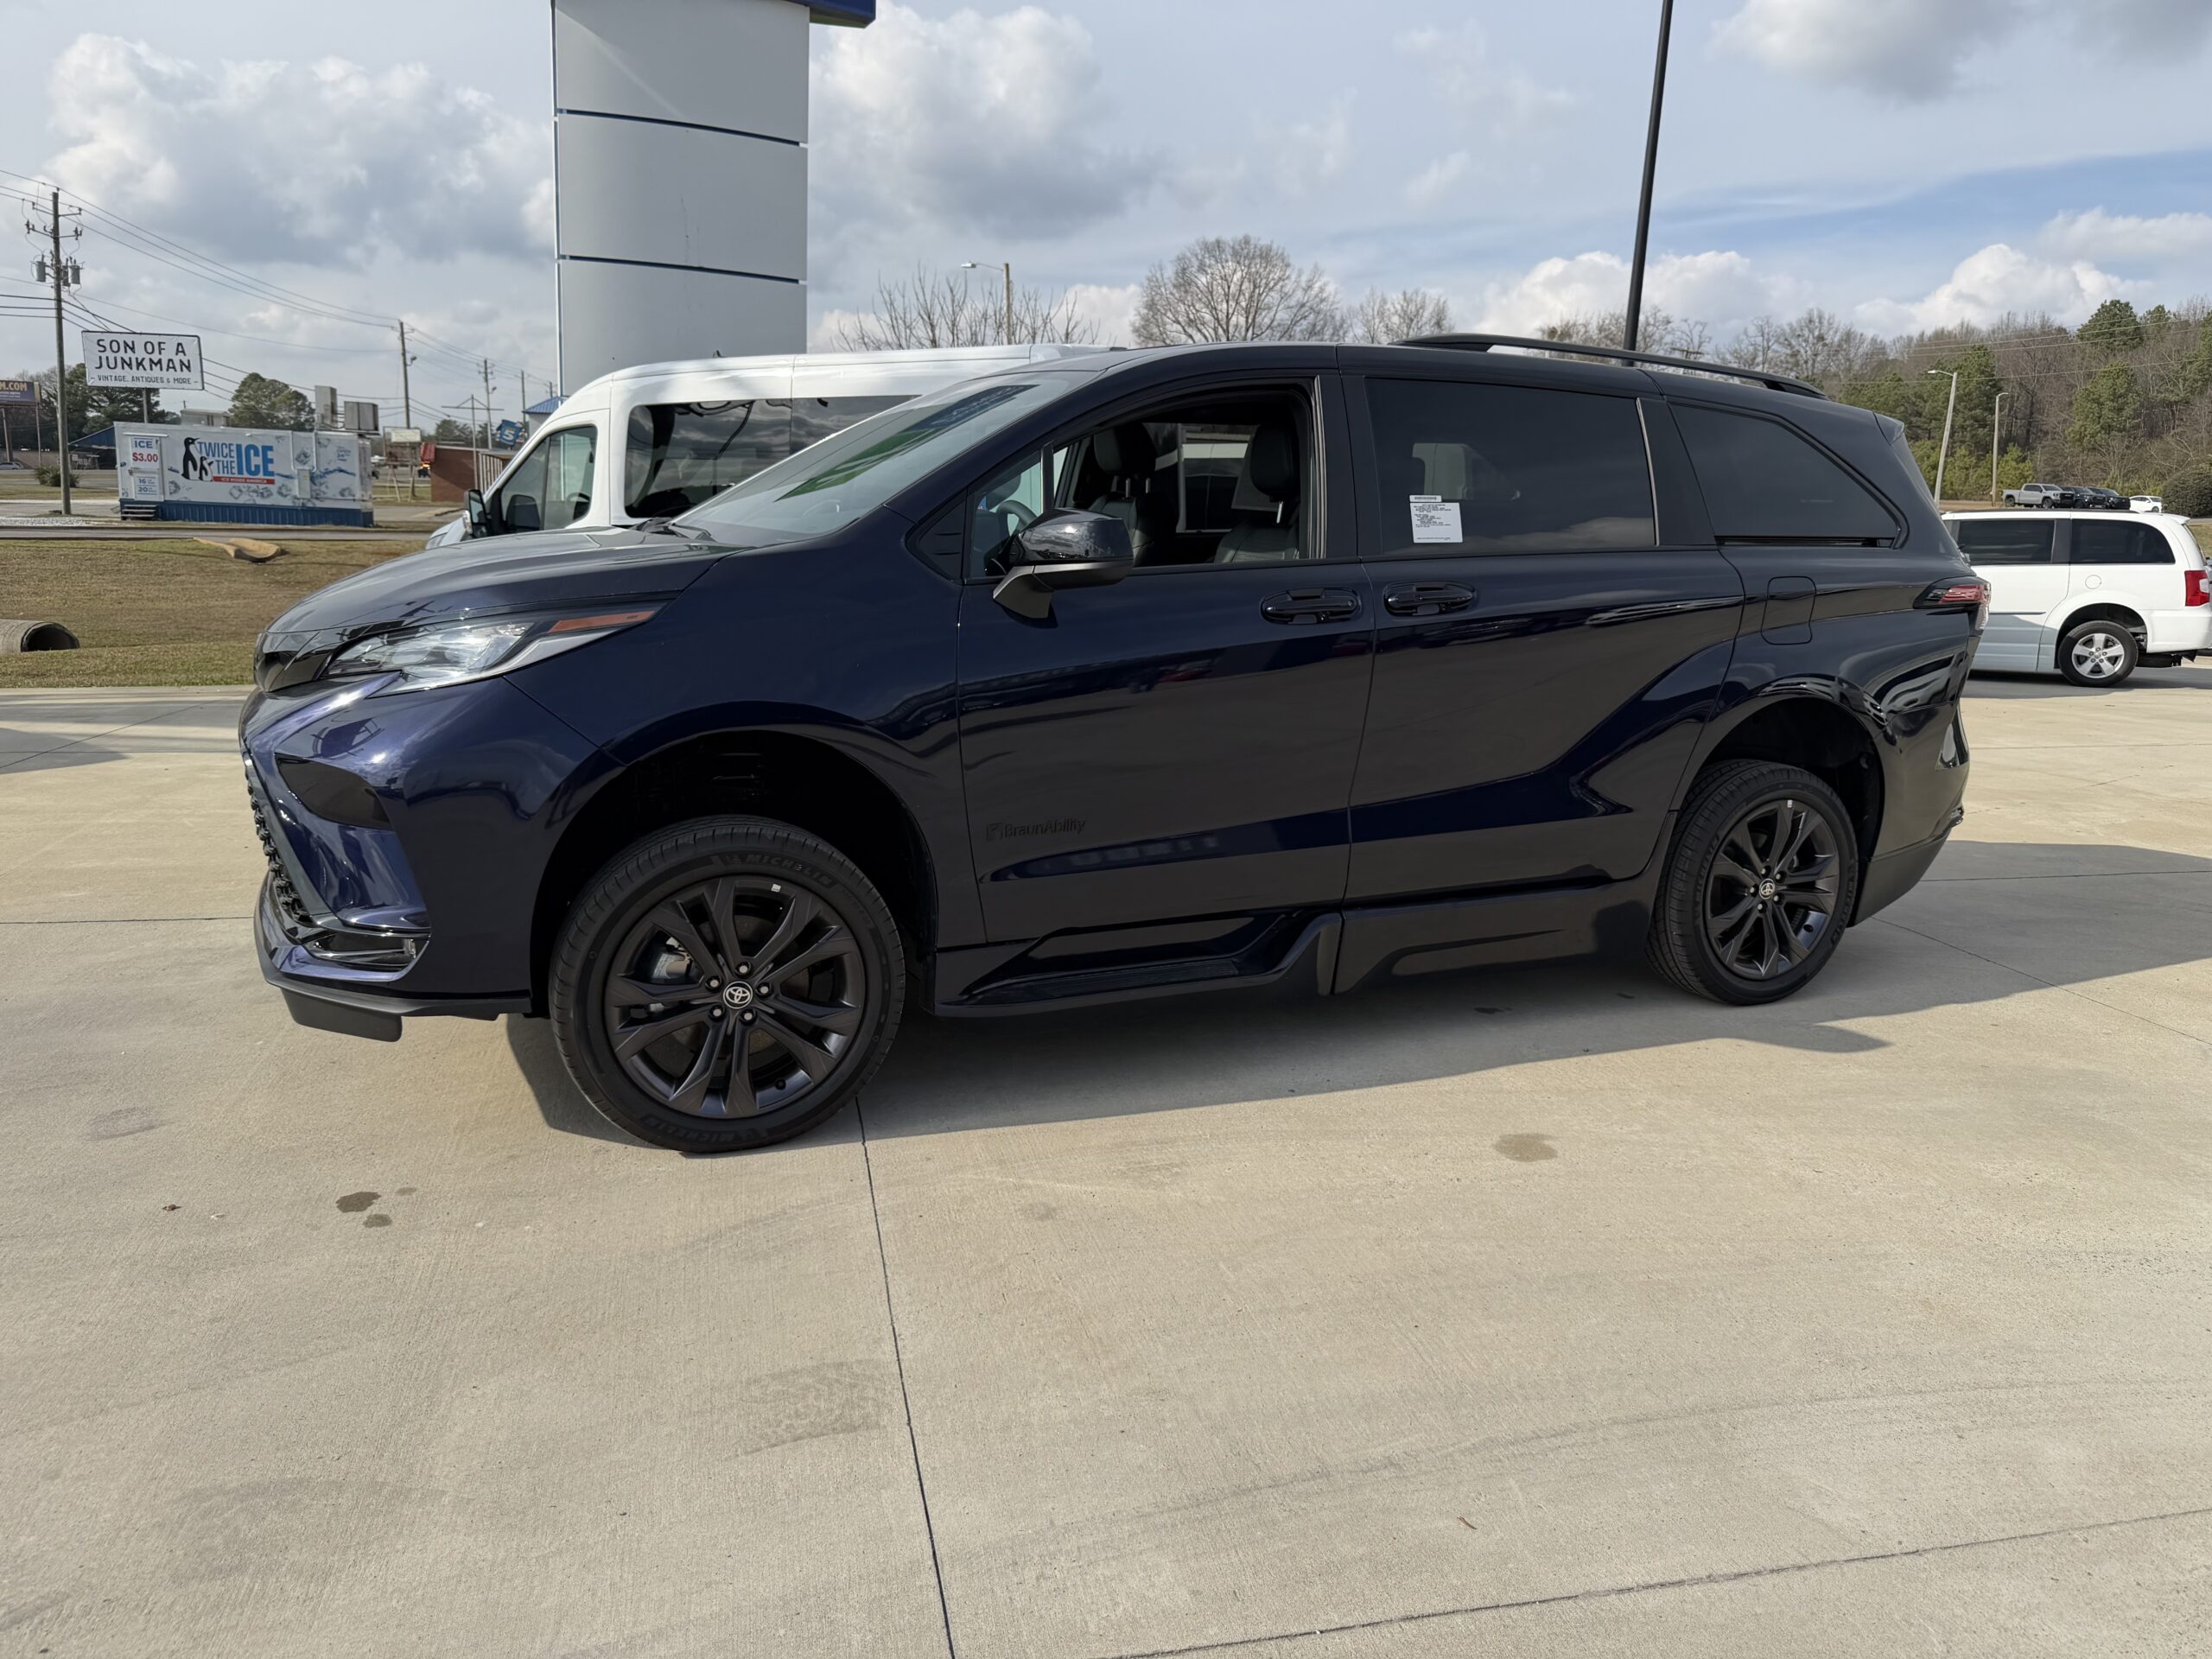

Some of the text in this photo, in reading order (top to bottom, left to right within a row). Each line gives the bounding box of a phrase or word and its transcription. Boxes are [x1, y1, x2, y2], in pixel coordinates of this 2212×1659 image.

[96, 339, 187, 356] SON OF A
[95, 355, 192, 372] JUNKMAN
[131, 375, 165, 384] ANTIQUES
[134, 440, 153, 448] ICE
[197, 442, 235, 459] TWICE
[132, 452, 158, 462] $3.00
[235, 443, 275, 477] ICE
[215, 460, 236, 475] THE
[746, 854, 833, 887] MICHELIN
